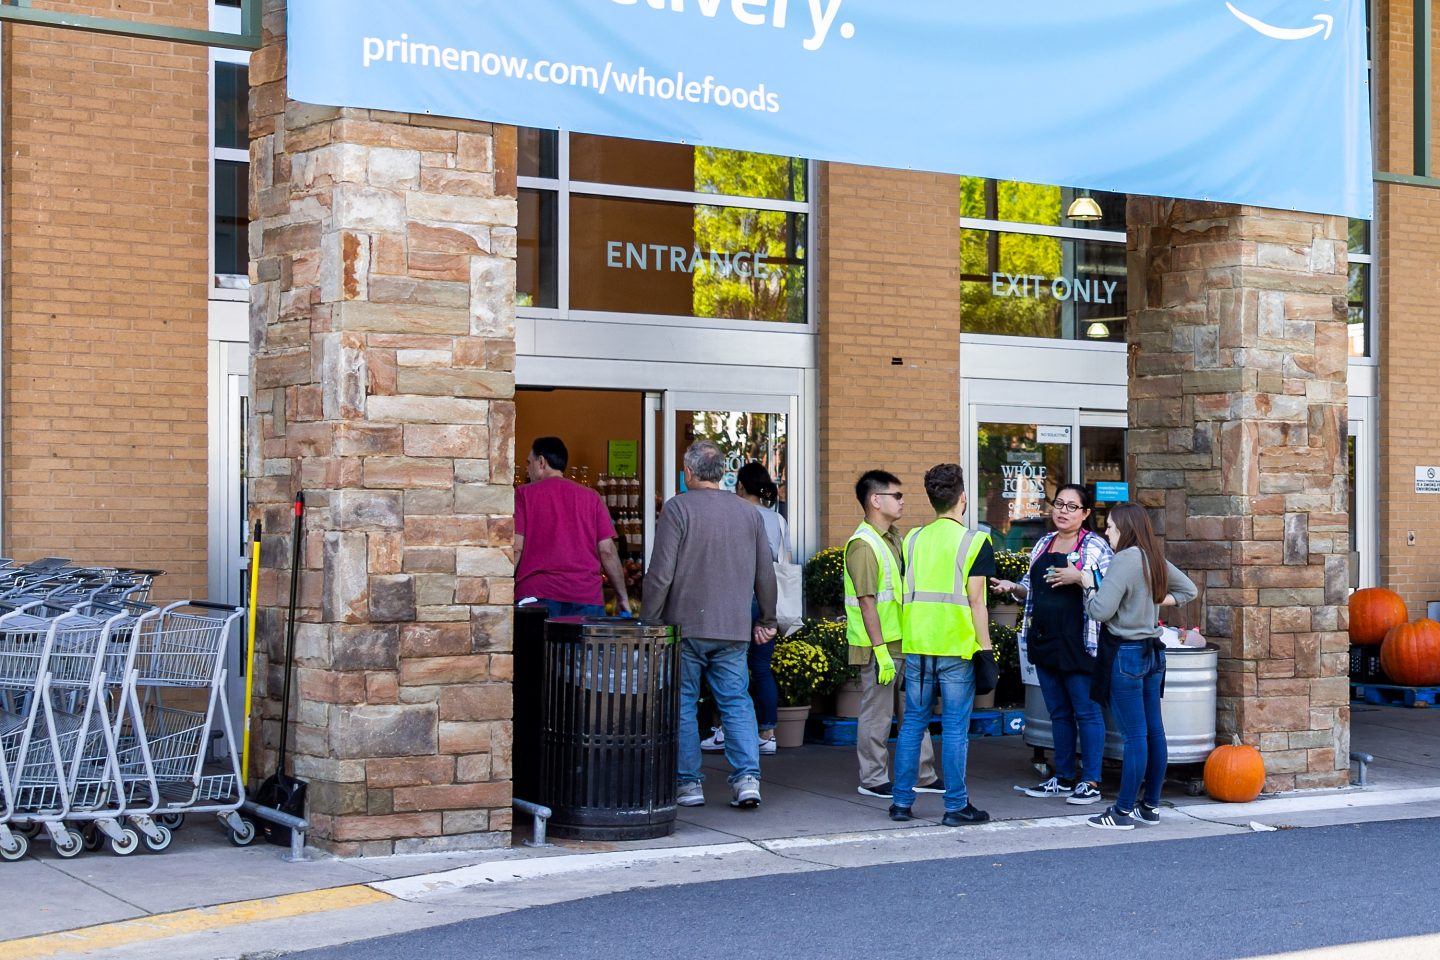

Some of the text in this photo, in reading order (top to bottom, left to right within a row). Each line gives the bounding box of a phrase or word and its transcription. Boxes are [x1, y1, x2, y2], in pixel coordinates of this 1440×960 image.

[361, 33, 780, 114] primenow.com/wholefoods
[606, 240, 769, 279] ENTRANCE
[992, 271, 1118, 304] EXIT ONLY
[1001, 460, 1047, 479] WHOLE
[1004, 479, 1045, 492] FOODS
